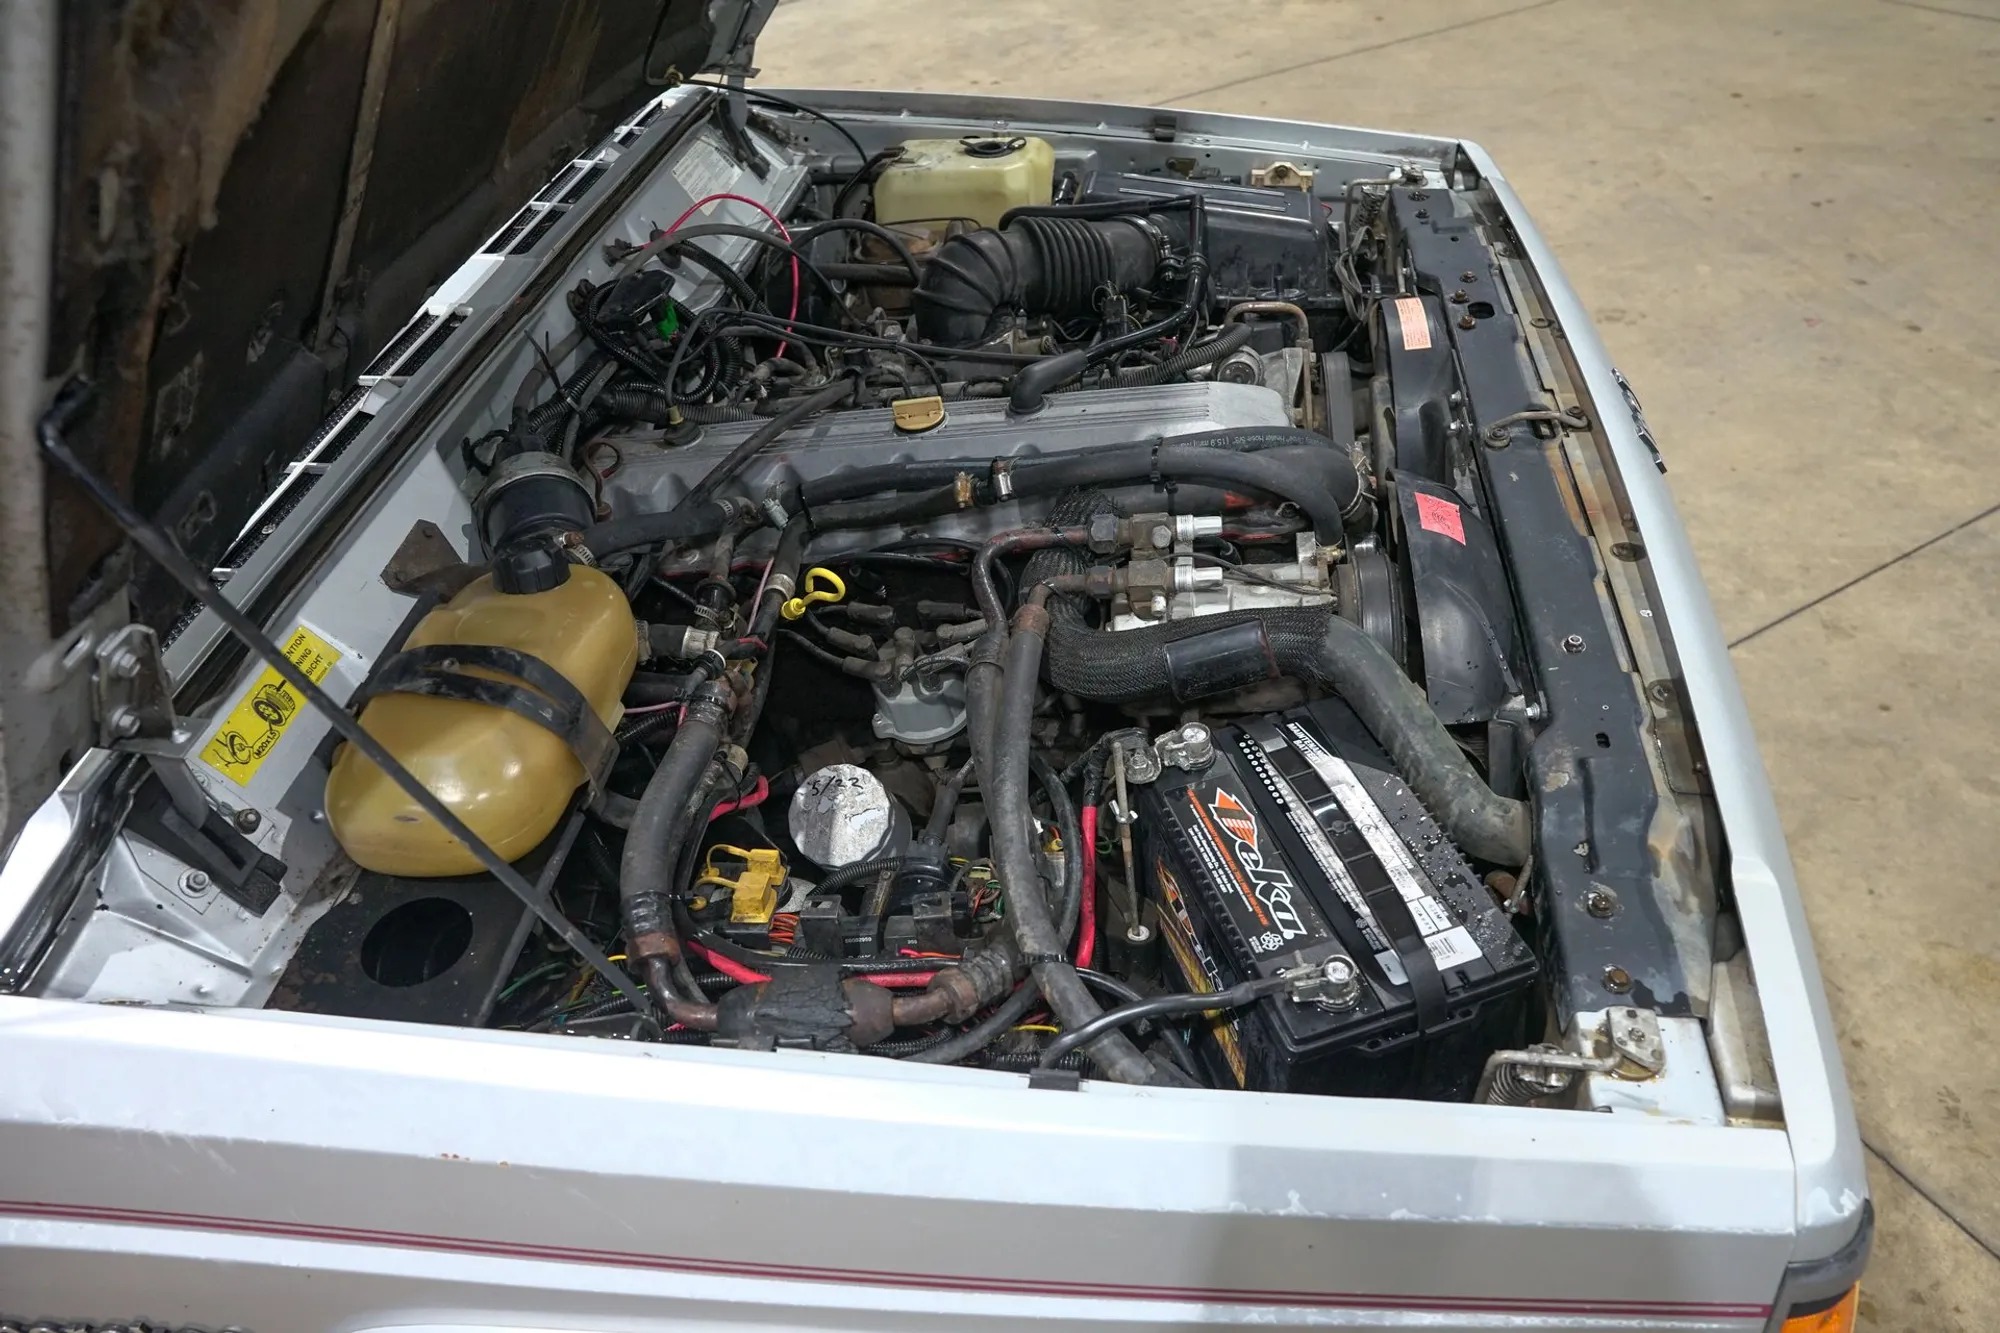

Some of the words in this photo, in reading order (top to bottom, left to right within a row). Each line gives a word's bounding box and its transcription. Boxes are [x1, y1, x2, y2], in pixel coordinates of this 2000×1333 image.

[284, 634, 306, 660] ENTION
[293, 648, 312, 668] NING
[306, 654, 324, 676] SICHT
[807, 776, 864, 797] 5/22
